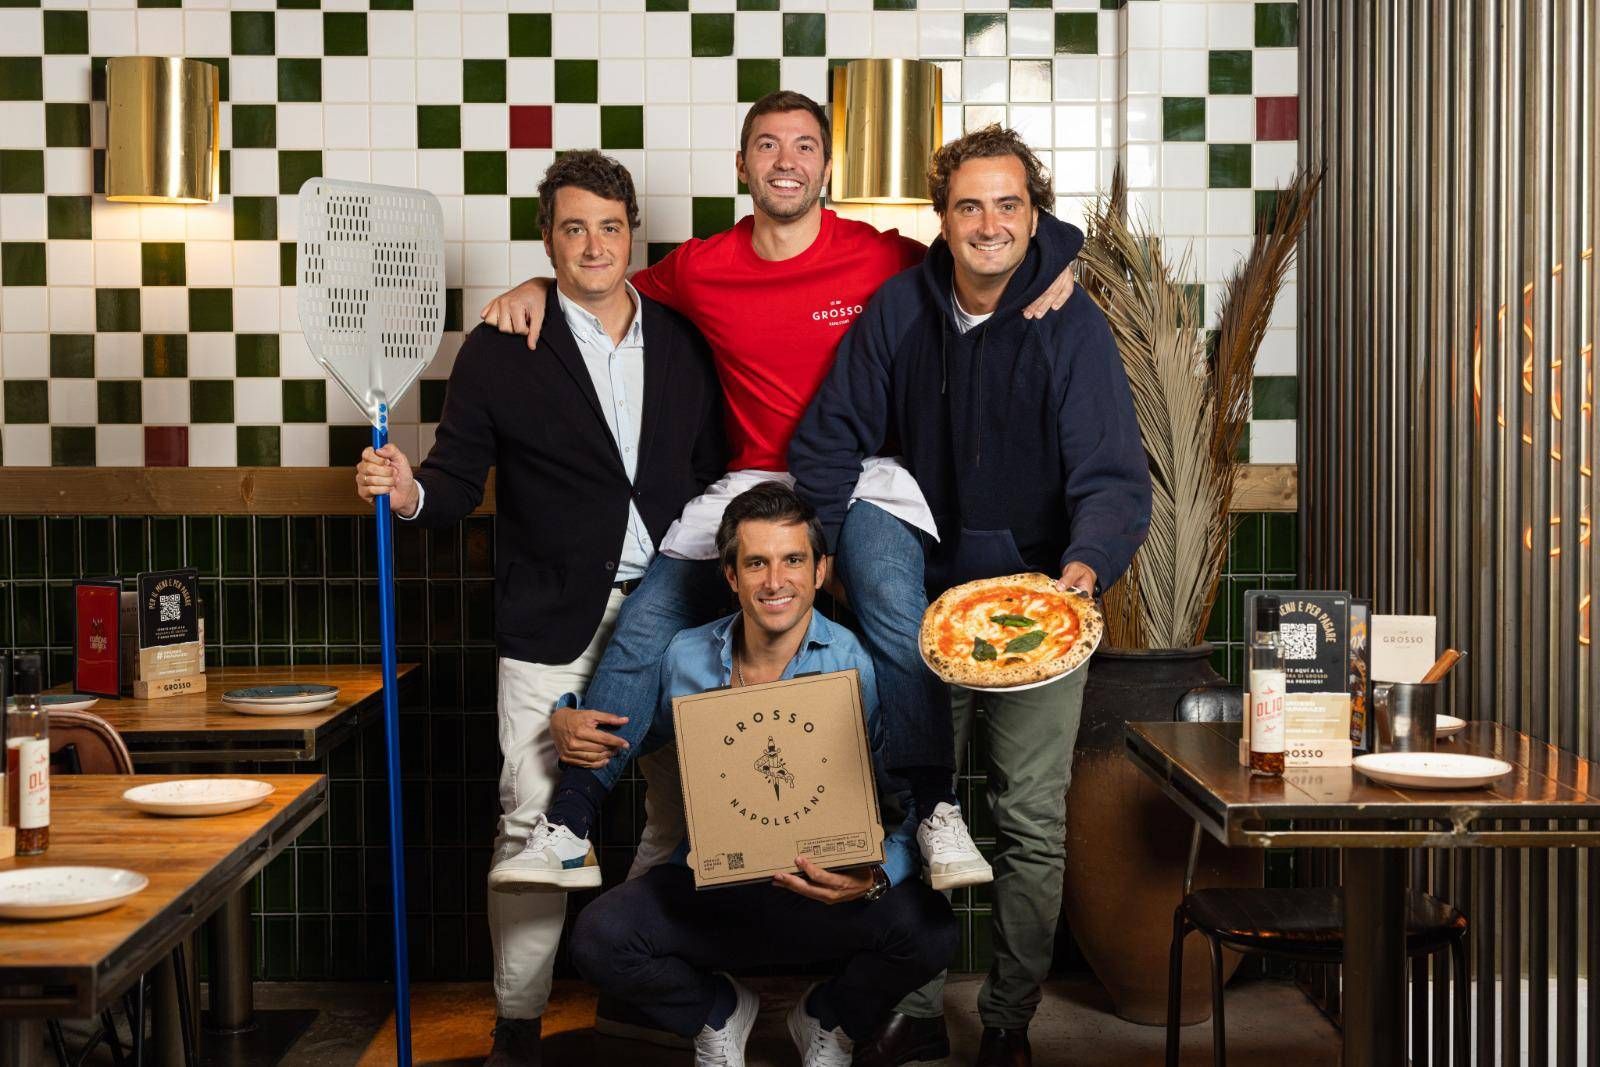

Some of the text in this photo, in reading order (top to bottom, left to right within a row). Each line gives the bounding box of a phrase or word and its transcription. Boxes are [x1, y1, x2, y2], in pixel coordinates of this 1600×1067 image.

[812, 305, 863, 321] GROSSO
[1278, 601, 1296, 617] ENU
[1304, 602, 1322, 618] PER
[1317, 612, 1337, 643] PAGARE
[1382, 635, 1424, 644] GROSSO
[163, 682, 191, 691] GROSSO
[1256, 697, 1282, 717] OLIO
[723, 709, 815, 746] GROSSO
[730, 784, 825, 826] NAPOLETANO
